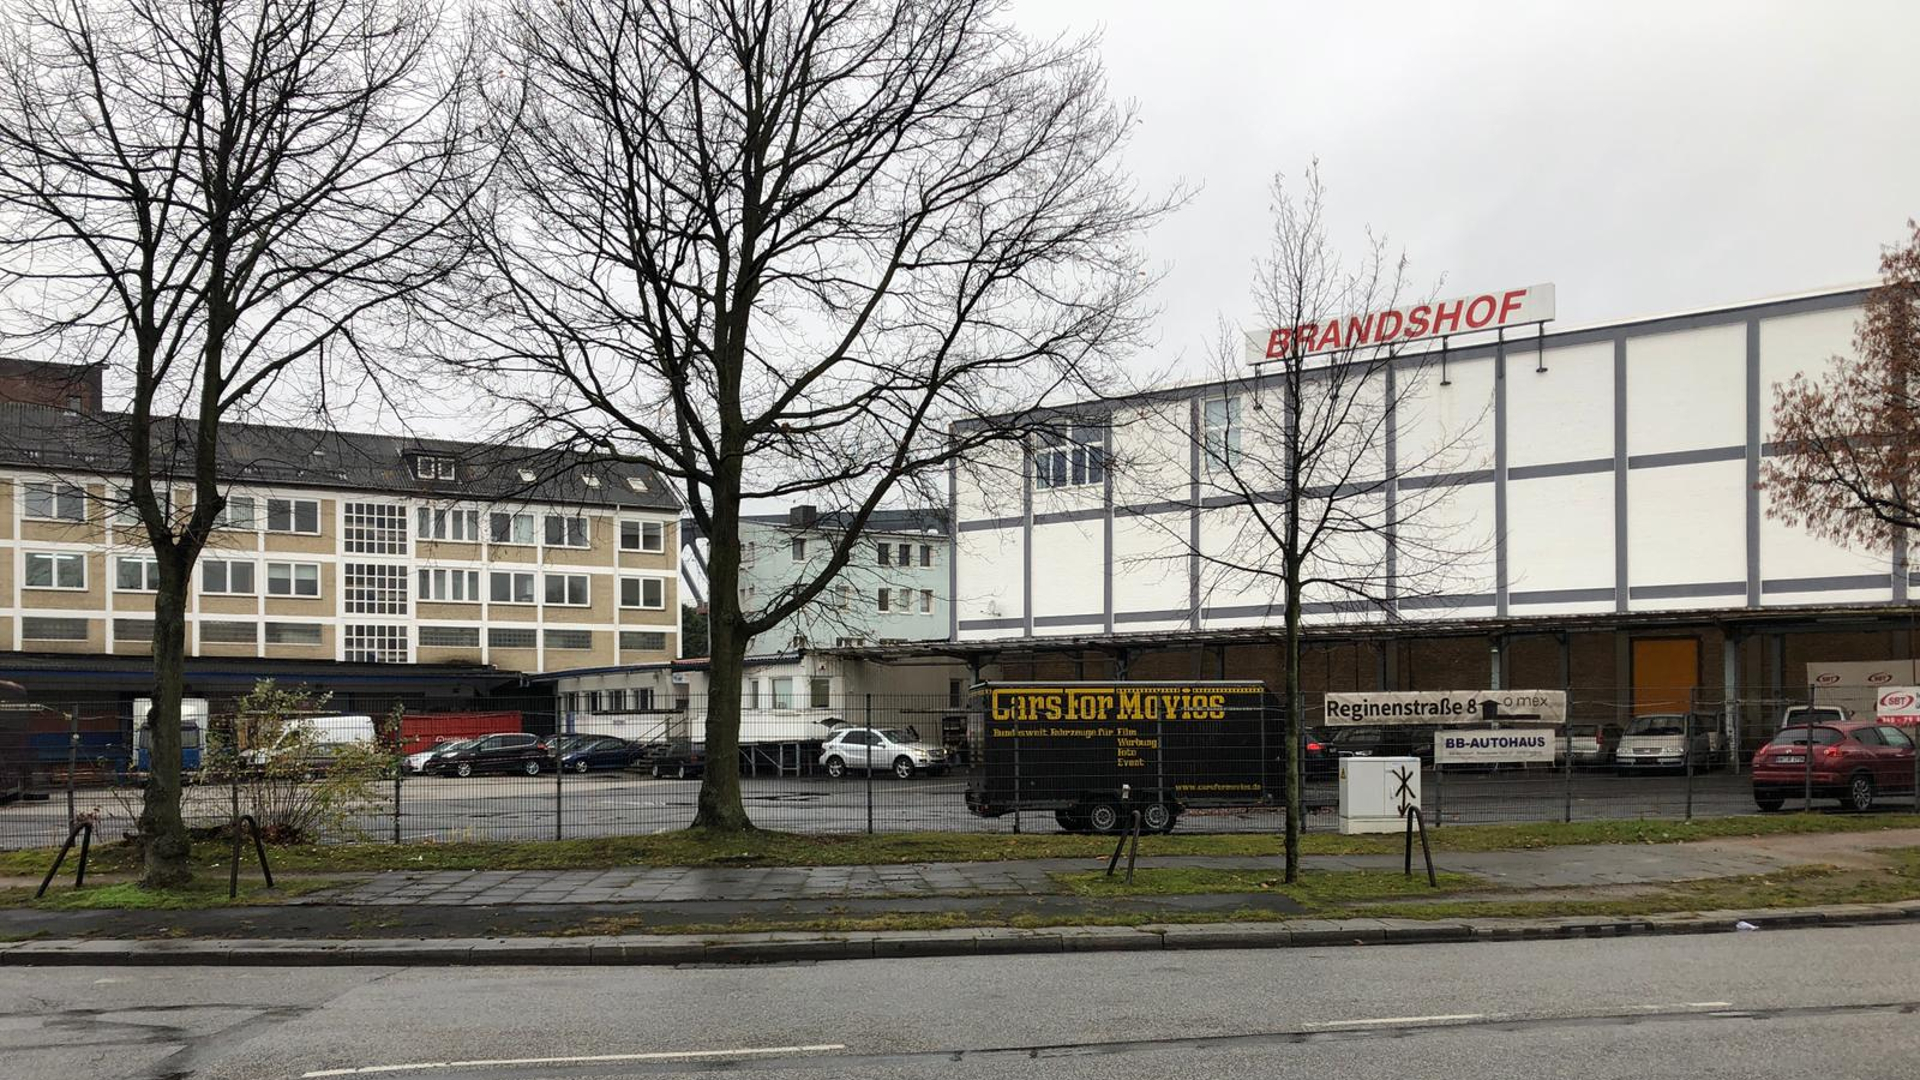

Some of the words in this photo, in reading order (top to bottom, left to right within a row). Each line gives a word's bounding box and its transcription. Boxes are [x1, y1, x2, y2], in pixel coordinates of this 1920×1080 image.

[1266, 289, 1527, 359] BRANDSHOF
[992, 688, 1063, 720] Cars
[1065, 688, 1114, 720] For
[1117, 688, 1225, 720] Movies
[1888, 696, 1906, 705] SBT
[1327, 698, 1462, 721] Reginenstraße
[1467, 699, 1478, 714] 8
[1050, 728, 1096, 739] Fahrzeuge
[1117, 738, 1158, 749] Werbung
[1445, 736, 1546, 749] BB-AUTOHAUS
